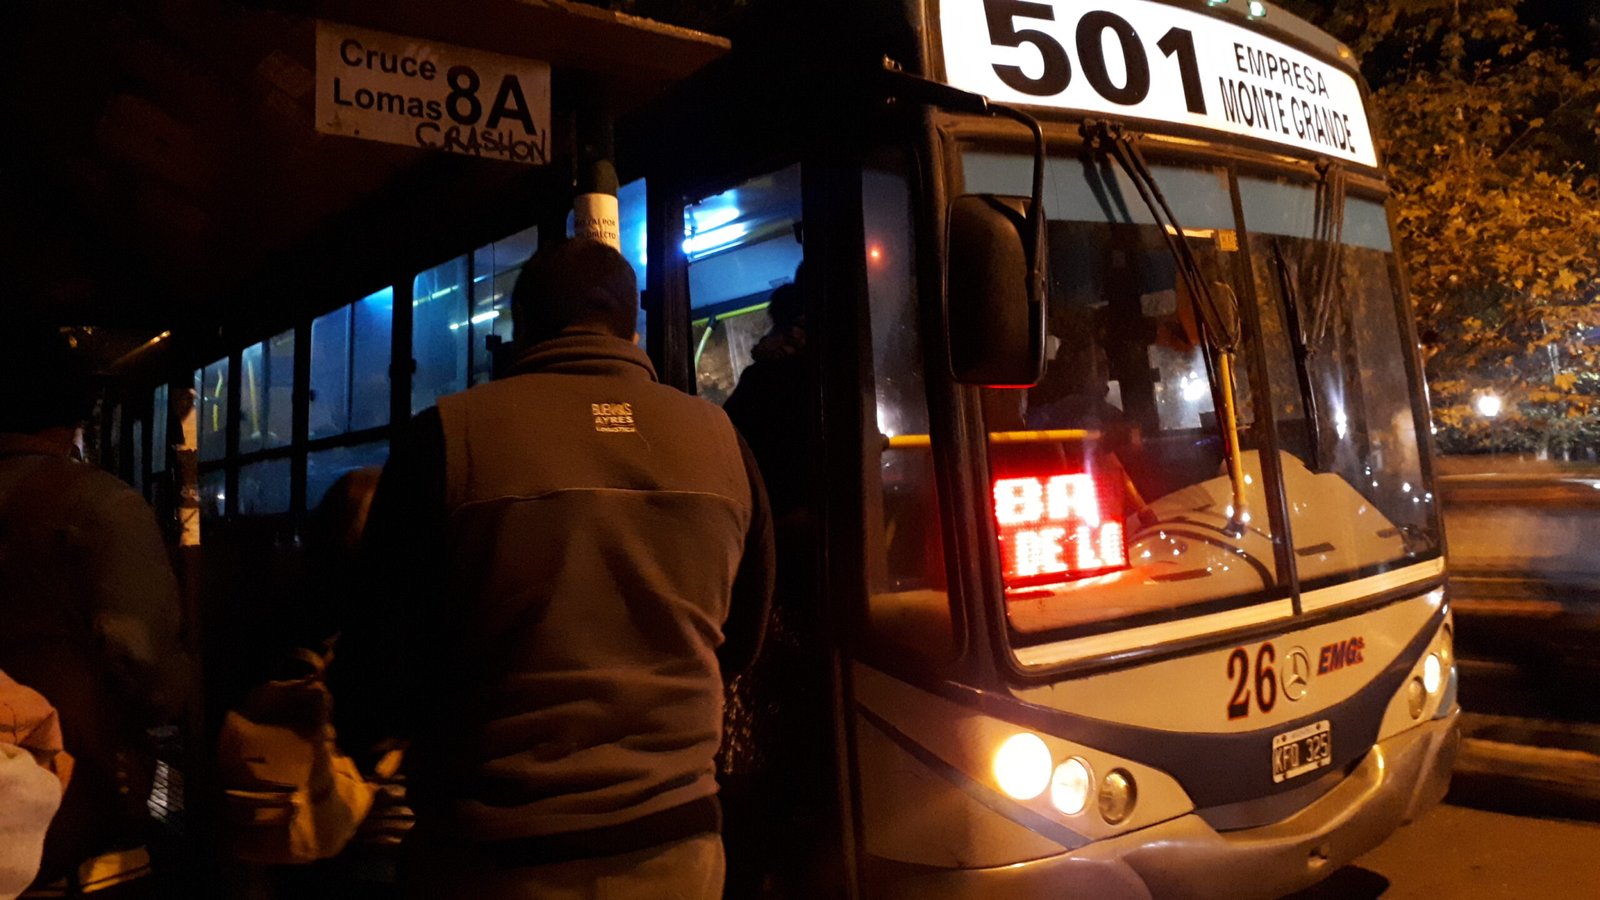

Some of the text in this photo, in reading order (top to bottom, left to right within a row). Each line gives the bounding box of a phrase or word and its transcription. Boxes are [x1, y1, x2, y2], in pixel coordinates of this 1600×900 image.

[340, 38, 437, 81] Cruce
[982, 0, 1208, 116] 501
[1234, 41, 1330, 98] EMPRESA
[333, 77, 442, 120] Lomas
[446, 65, 535, 136] 8A
[1218, 77, 1356, 154] MONTE GRANDE
[1227, 642, 1277, 721] 26
[1305, 732, 1328, 762] 325
